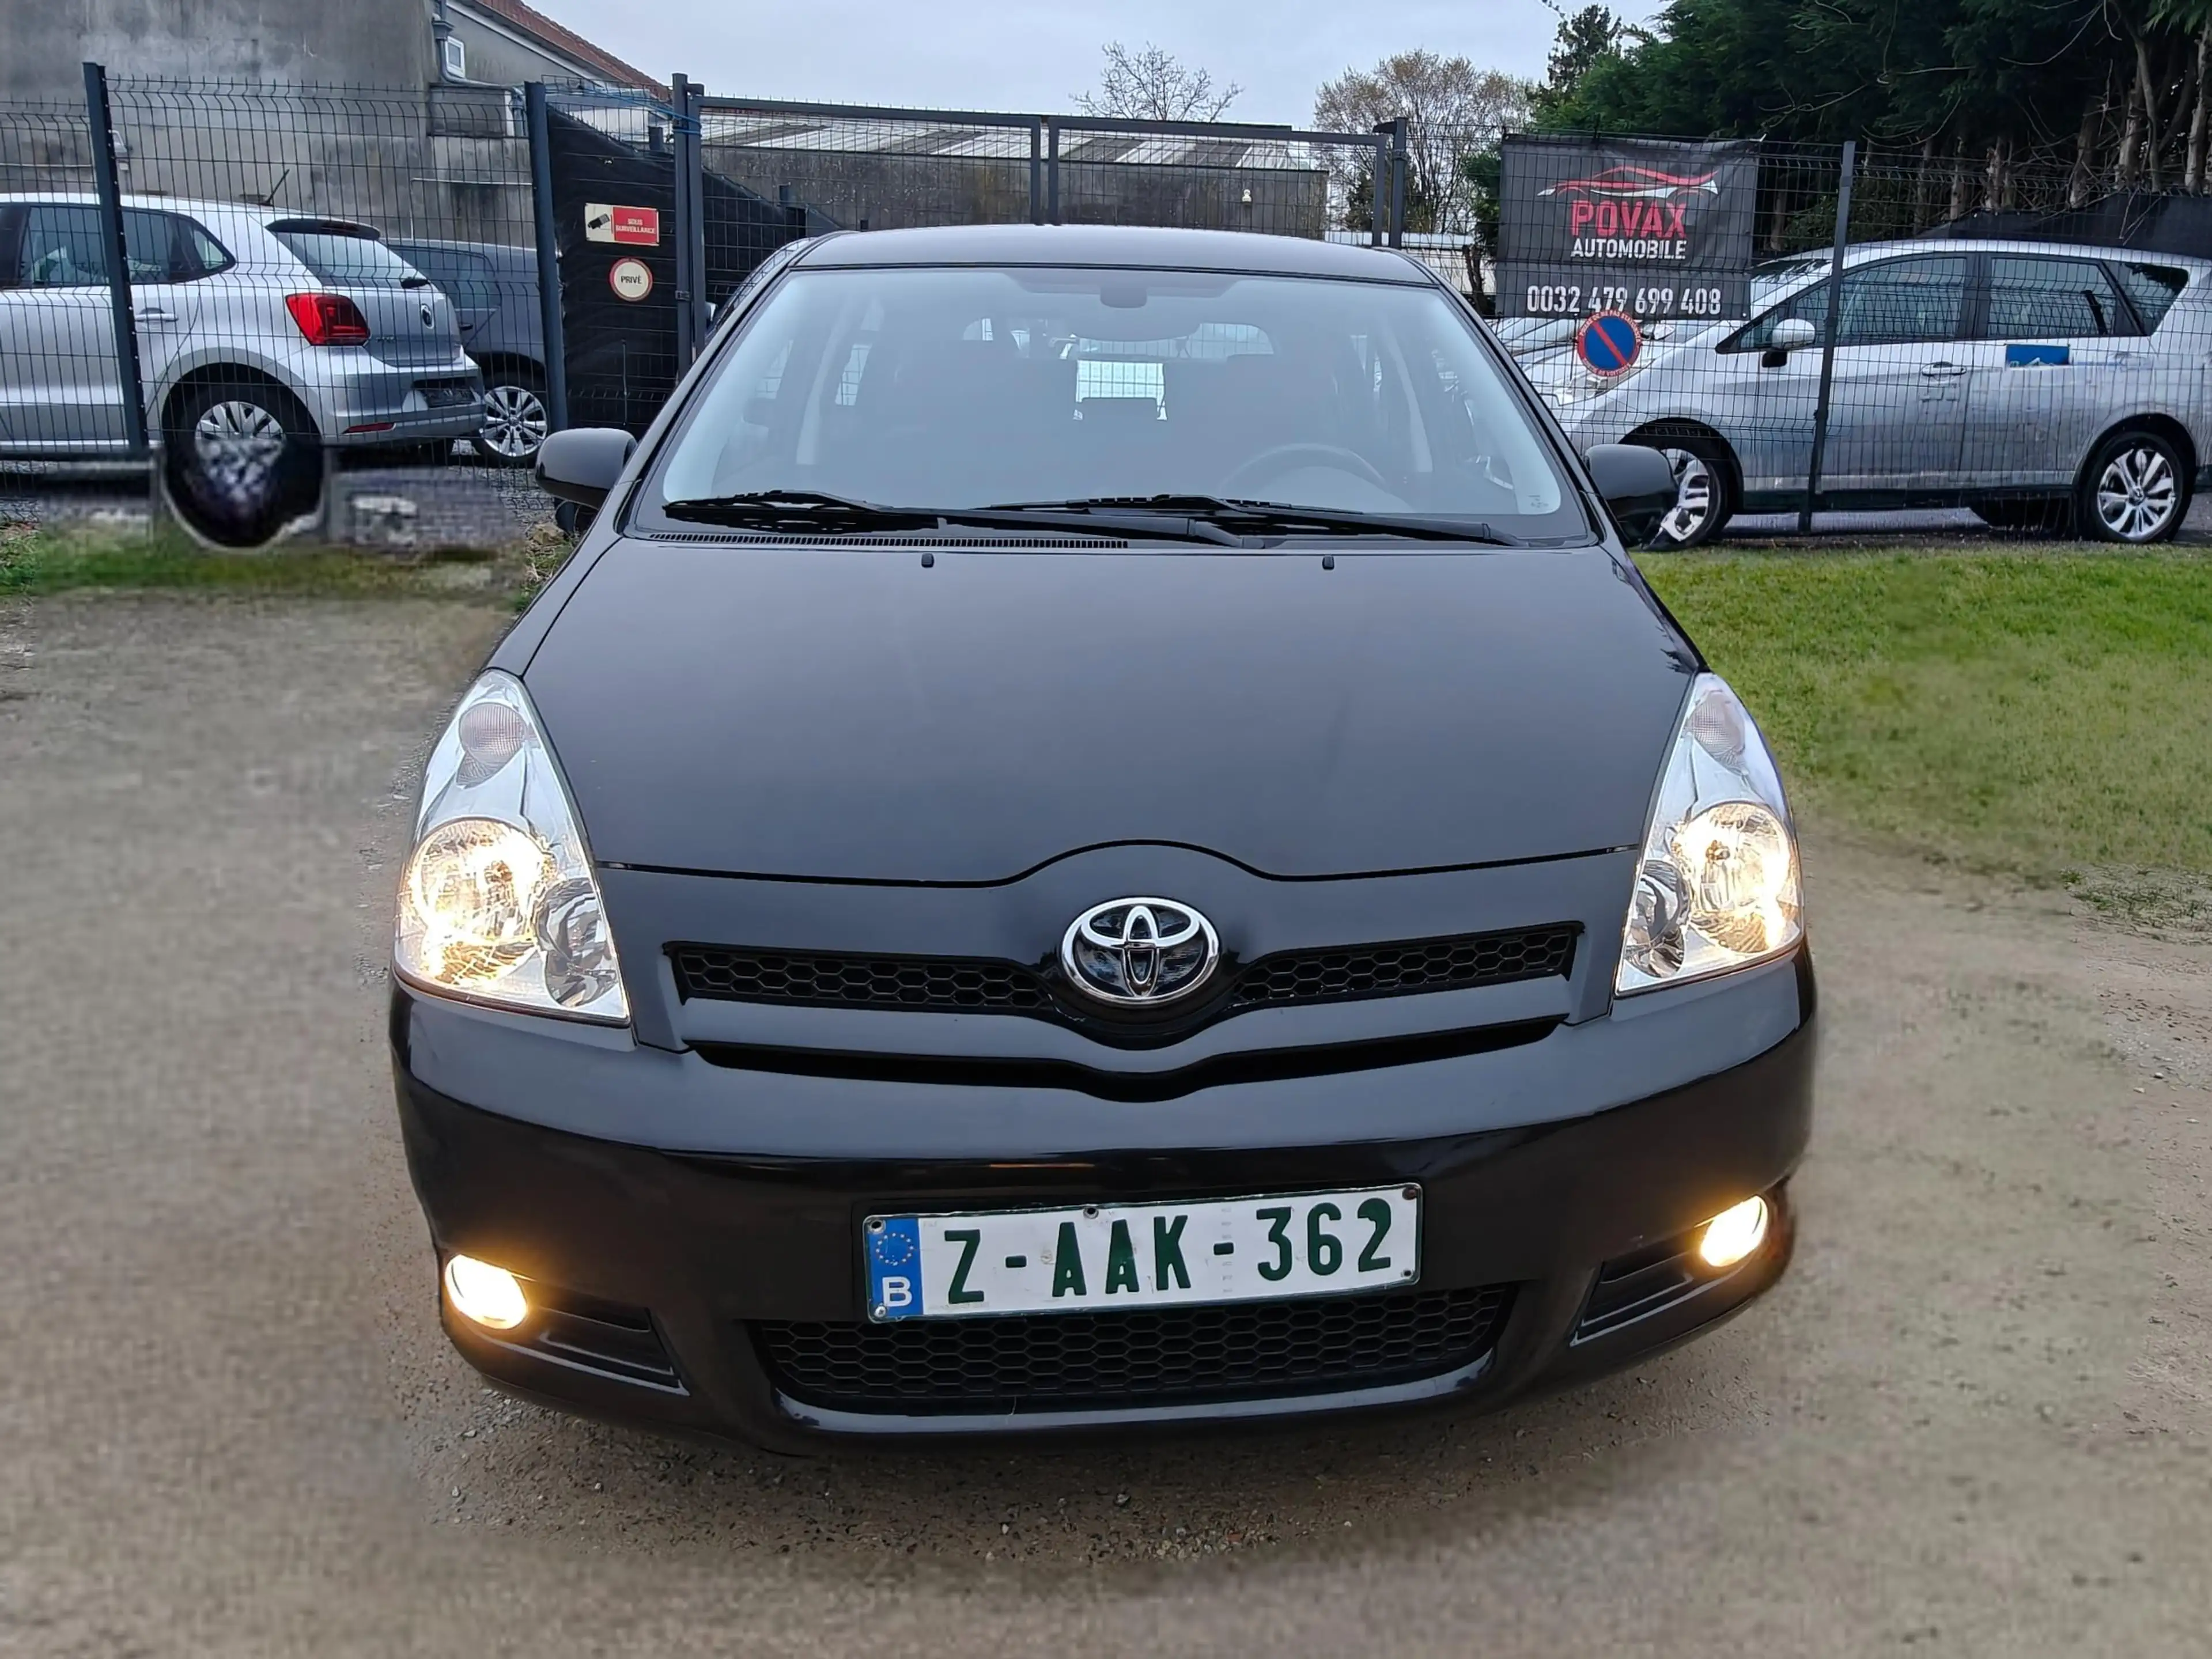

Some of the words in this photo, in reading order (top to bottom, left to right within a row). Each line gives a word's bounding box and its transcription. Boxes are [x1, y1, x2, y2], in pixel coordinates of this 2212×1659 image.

[1571, 199, 1687, 238] POVAX
[1570, 238, 1687, 259] AUTOMOBILE
[621, 274, 642, 284] PRIVÉ
[1527, 285, 1580, 312] 0032
[1588, 287, 1628, 313] 479
[1635, 288, 1673, 314] 699
[1681, 288, 1721, 315] 408
[944, 1197, 1392, 1304] Z-AAK-362
[882, 1277, 913, 1306] B
